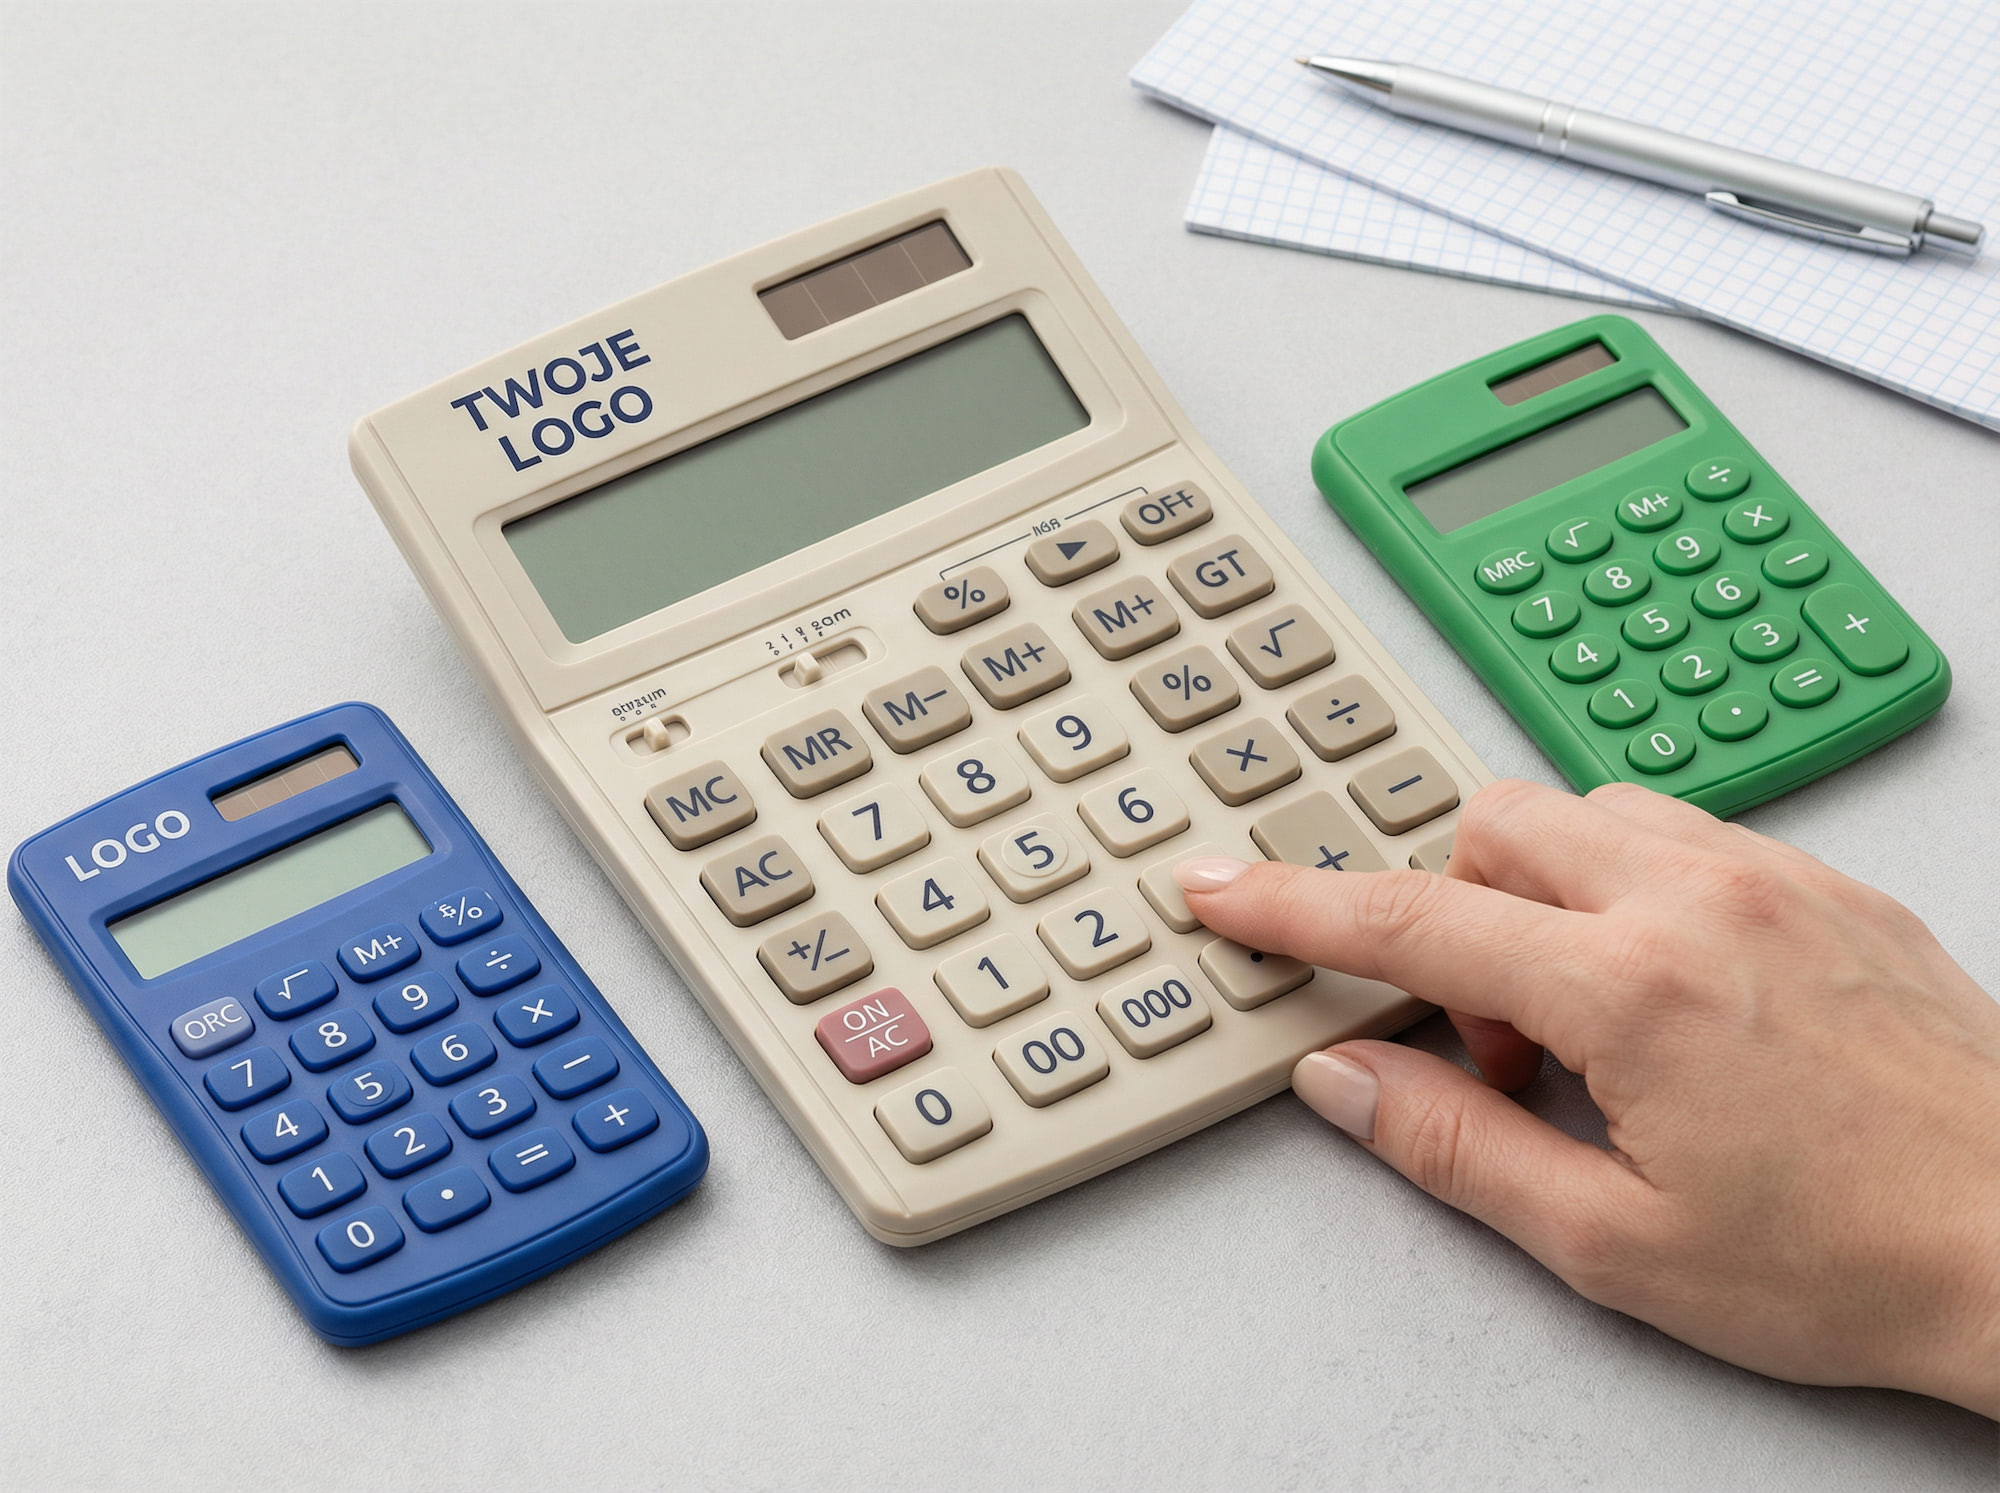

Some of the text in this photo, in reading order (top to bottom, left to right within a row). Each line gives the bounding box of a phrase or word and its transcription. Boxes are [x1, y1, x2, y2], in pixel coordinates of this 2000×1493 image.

[450, 327, 652, 432] TWOJE
[497, 384, 654, 473] LOGO
[1708, 466, 1730, 482] ÷
[1628, 494, 1668, 518] M+
[1676, 536, 1700, 559] 9
[1196, 550, 1245, 588] GT
[1483, 551, 1535, 582] MRC
[1605, 566, 1632, 589] 8
[943, 580, 985, 609] %
[1716, 577, 1741, 600] 6
[1093, 595, 1153, 633] M+
[1532, 596, 1553, 621] 7
[1642, 608, 1670, 634] 5
[1753, 623, 1780, 646] 3
[1845, 613, 1869, 634] +
[983, 643, 1045, 681] M+
[1577, 642, 1598, 663] 4
[1682, 655, 1712, 679] 2
[1162, 664, 1212, 700] %
[1793, 669, 1822, 688] =
[1327, 699, 1360, 725] ÷
[1613, 688, 1635, 708] 1
[1055, 715, 1092, 751] 9
[1650, 733, 1675, 756] 0
[782, 727, 852, 771] MR
[956, 759, 996, 794] 8
[666, 775, 737, 822] MC
[1117, 787, 1154, 824] 6
[851, 801, 883, 841] 7
[63, 809, 191, 882] LOGO
[1014, 831, 1055, 870] 5
[1316, 845, 1349, 871] +
[735, 850, 793, 897] AC
[922, 877, 955, 912] 4
[1074, 909, 1119, 948] 2
[353, 934, 402, 965] M+
[485, 950, 513, 970] ÷
[977, 956, 1009, 990] 1
[401, 984, 429, 1011] 9
[1121, 979, 1192, 1028] 000
[184, 1004, 243, 1041] ORC
[842, 998, 891, 1032] ON
[318, 1021, 348, 1048] 8
[441, 1034, 469, 1061] 6
[868, 1024, 909, 1058] AC
[1022, 1027, 1085, 1075] 00
[230, 1058, 253, 1088] 7
[353, 1072, 383, 1100] 5
[478, 1088, 508, 1116] 3
[604, 1104, 630, 1126] +
[915, 1088, 953, 1126] 0
[275, 1112, 299, 1137] 4
[393, 1127, 426, 1156] 2
[516, 1143, 549, 1166] =
[311, 1166, 334, 1191] 1
[346, 1220, 375, 1248] 0
